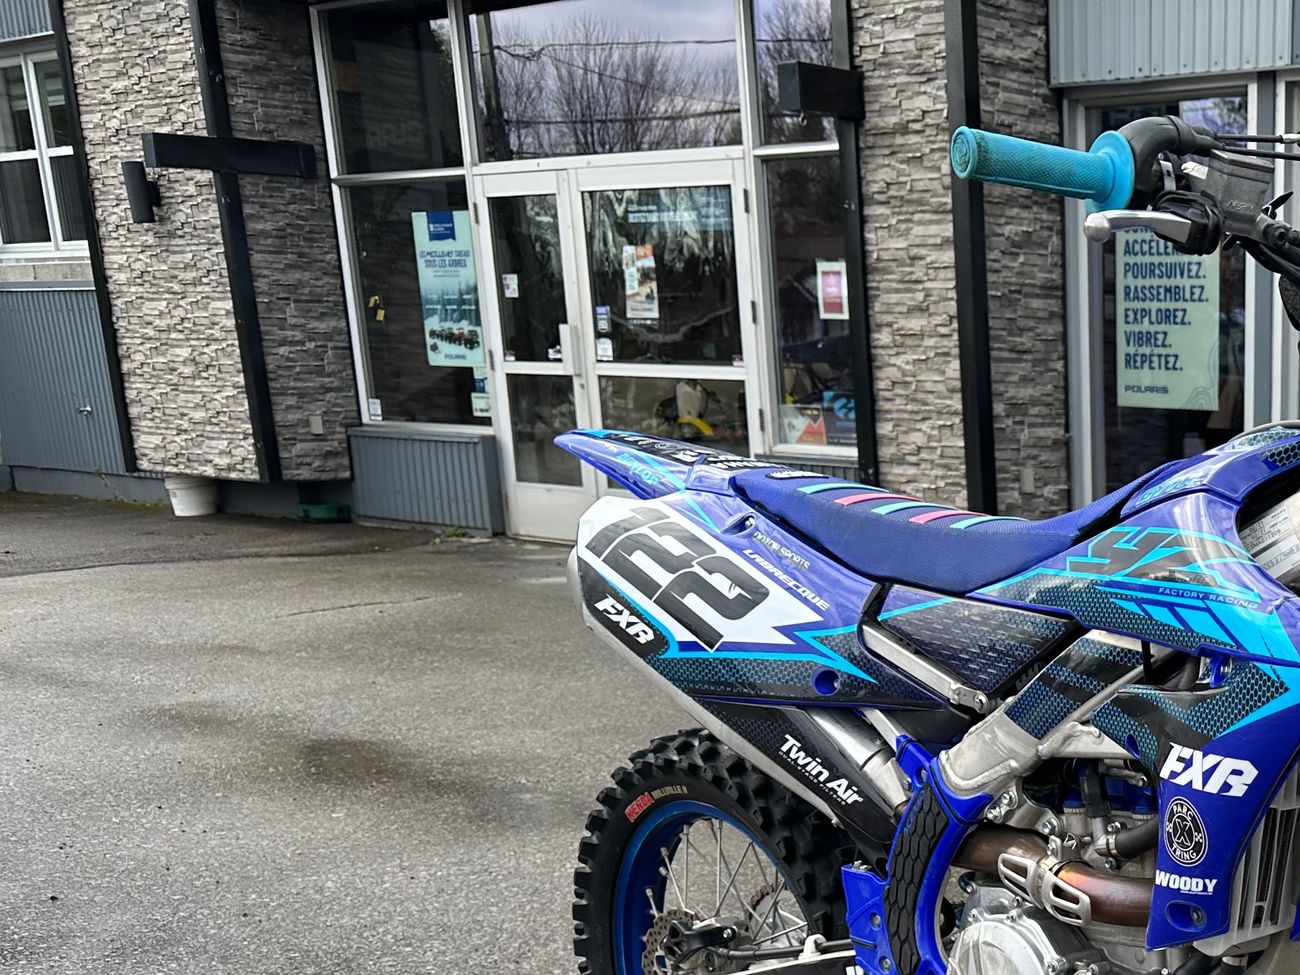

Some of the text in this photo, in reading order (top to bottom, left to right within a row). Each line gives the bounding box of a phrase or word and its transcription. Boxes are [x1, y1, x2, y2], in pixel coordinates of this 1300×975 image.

[1124, 262, 1206, 280] POURSUIVEZ.
[1124, 285, 1209, 303] RASSEMBLEZ.
[1124, 308, 1192, 326] EXPLOREZ.
[1124, 331, 1172, 348] VIBREZ.
[1124, 348, 1183, 372] RÉPÉTEZ.
[1125, 385, 1169, 395] POLARIS
[585, 507, 770, 650] 122
[742, 549, 831, 612] LABRECQUE
[1158, 588, 1258, 610] FACTORY RACING
[594, 593, 655, 645] FXR
[780, 734, 864, 806] Twin Air
[1159, 742, 1259, 797] FXR
[625, 791, 656, 823] KENDA
[1172, 803, 1194, 821] PARC
[1174, 818, 1192, 846] X
[1171, 843, 1197, 860] TRING
[1155, 869, 1218, 893] WOODY
